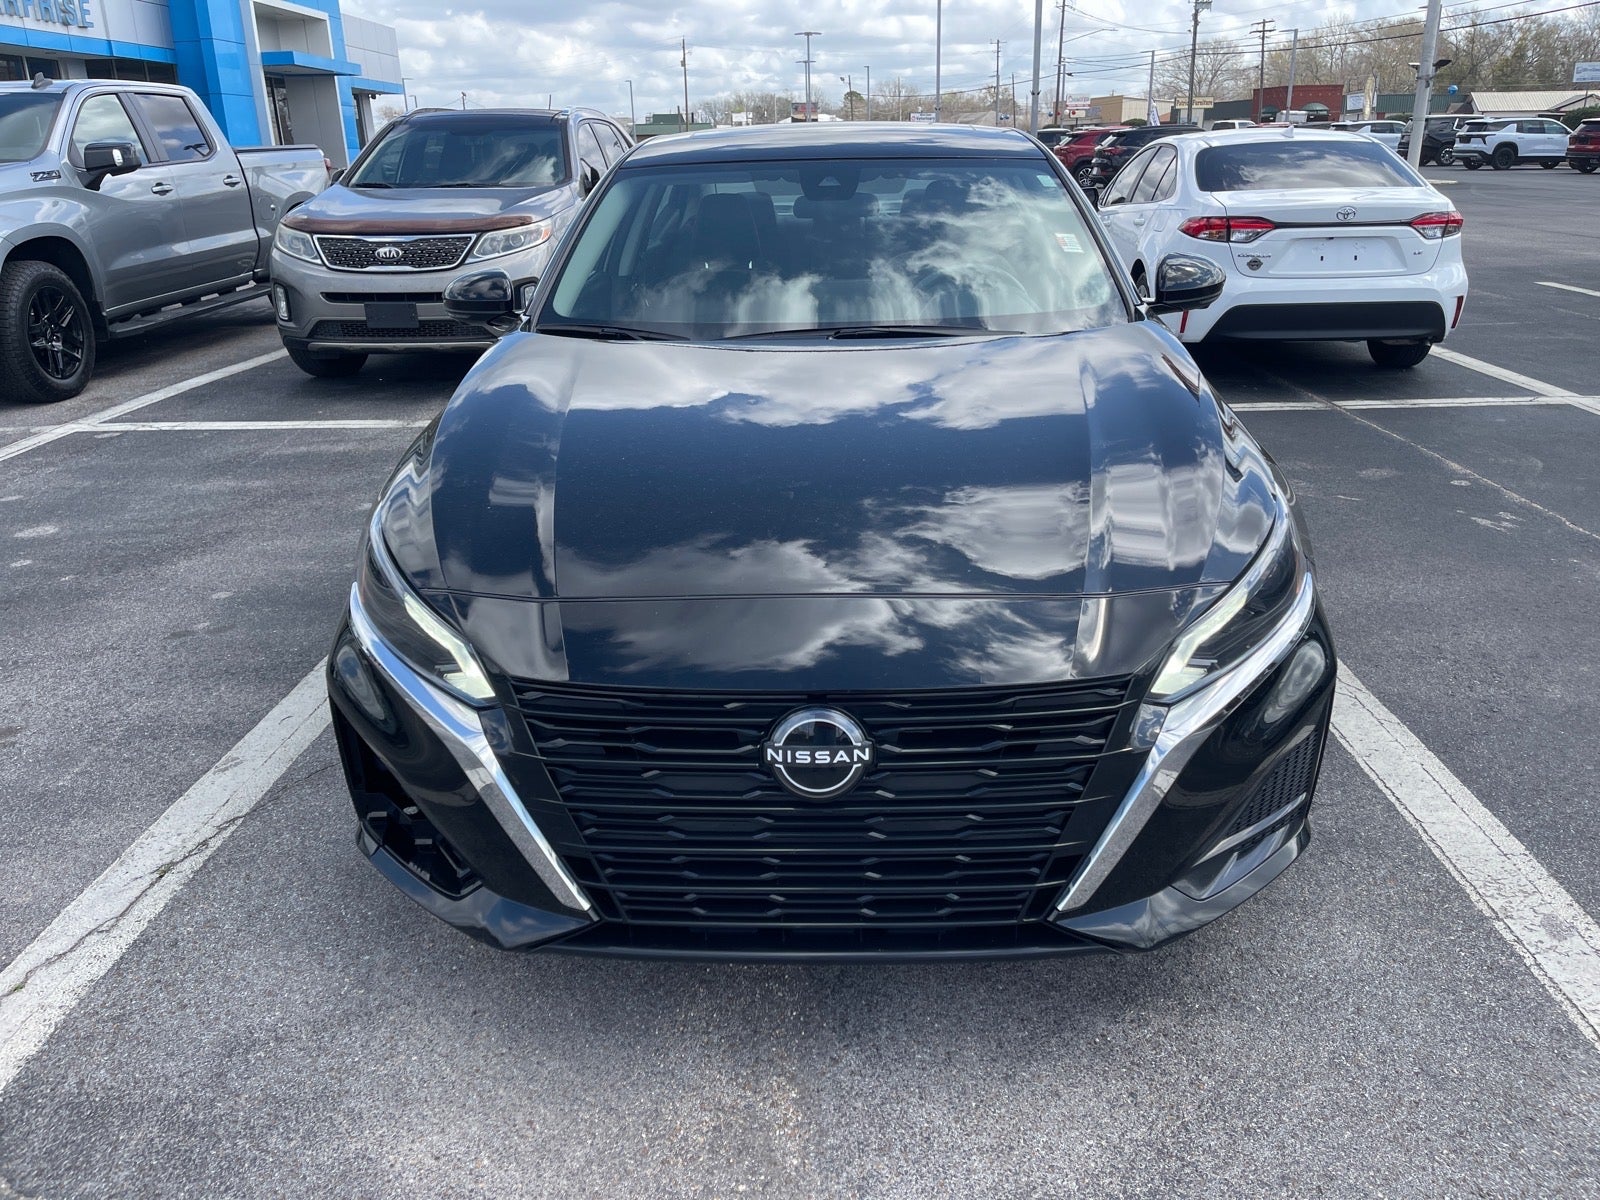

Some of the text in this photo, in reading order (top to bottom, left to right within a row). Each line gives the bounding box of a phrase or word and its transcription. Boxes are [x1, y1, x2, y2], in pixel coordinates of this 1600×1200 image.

[0, 0, 94, 28] RPRISE
[379, 247, 397, 258] KIA
[767, 748, 869, 764] NISSAN
